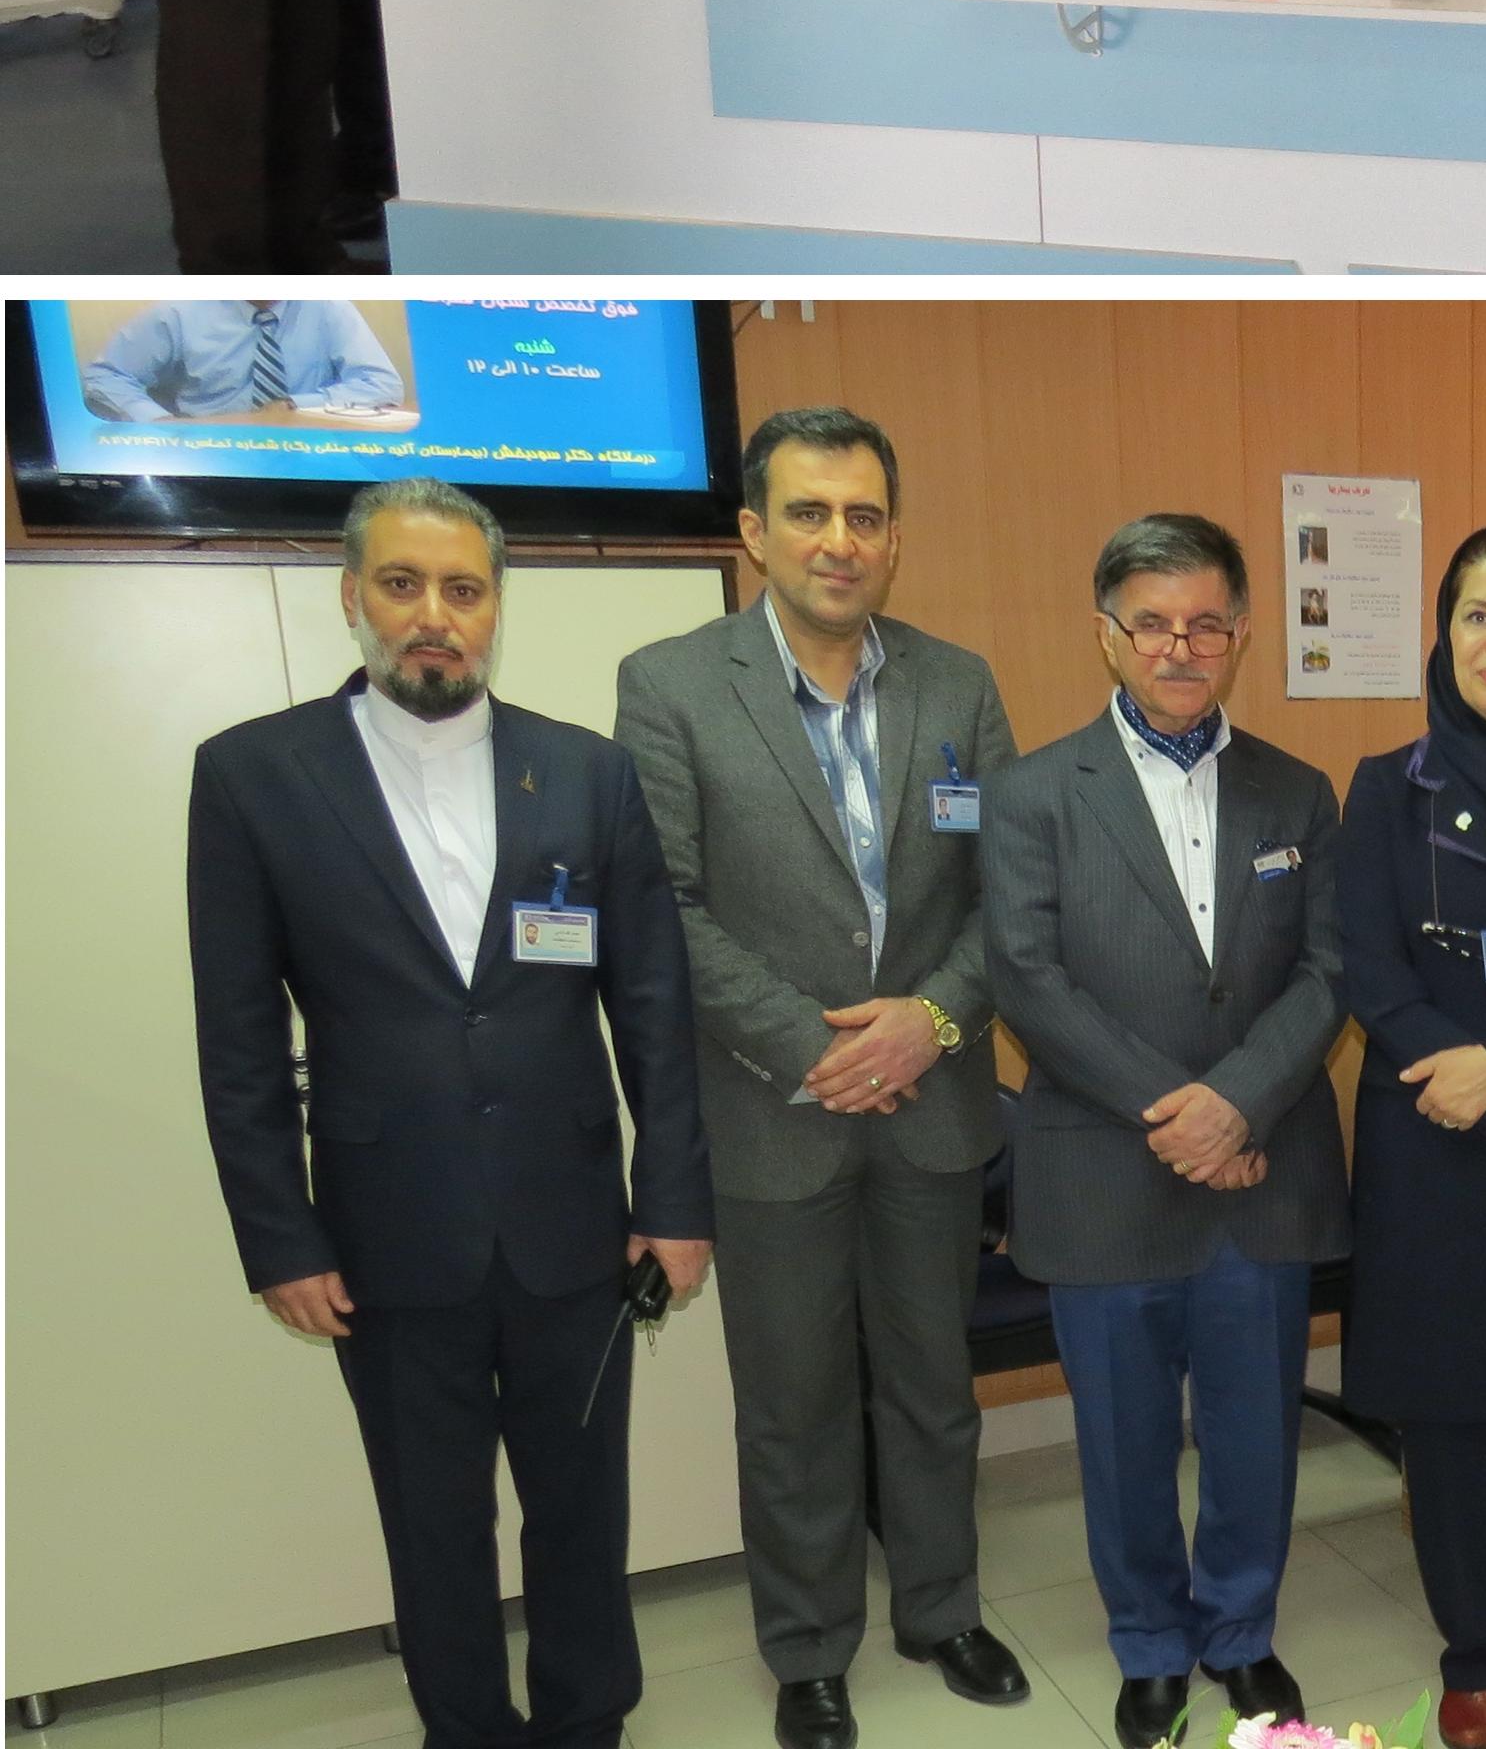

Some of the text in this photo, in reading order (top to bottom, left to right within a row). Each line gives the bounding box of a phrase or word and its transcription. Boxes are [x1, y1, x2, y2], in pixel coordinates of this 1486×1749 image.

[514, 339, 556, 357] شنبه
[491, 359, 517, 377] الی
[546, 362, 601, 379] ساعت
